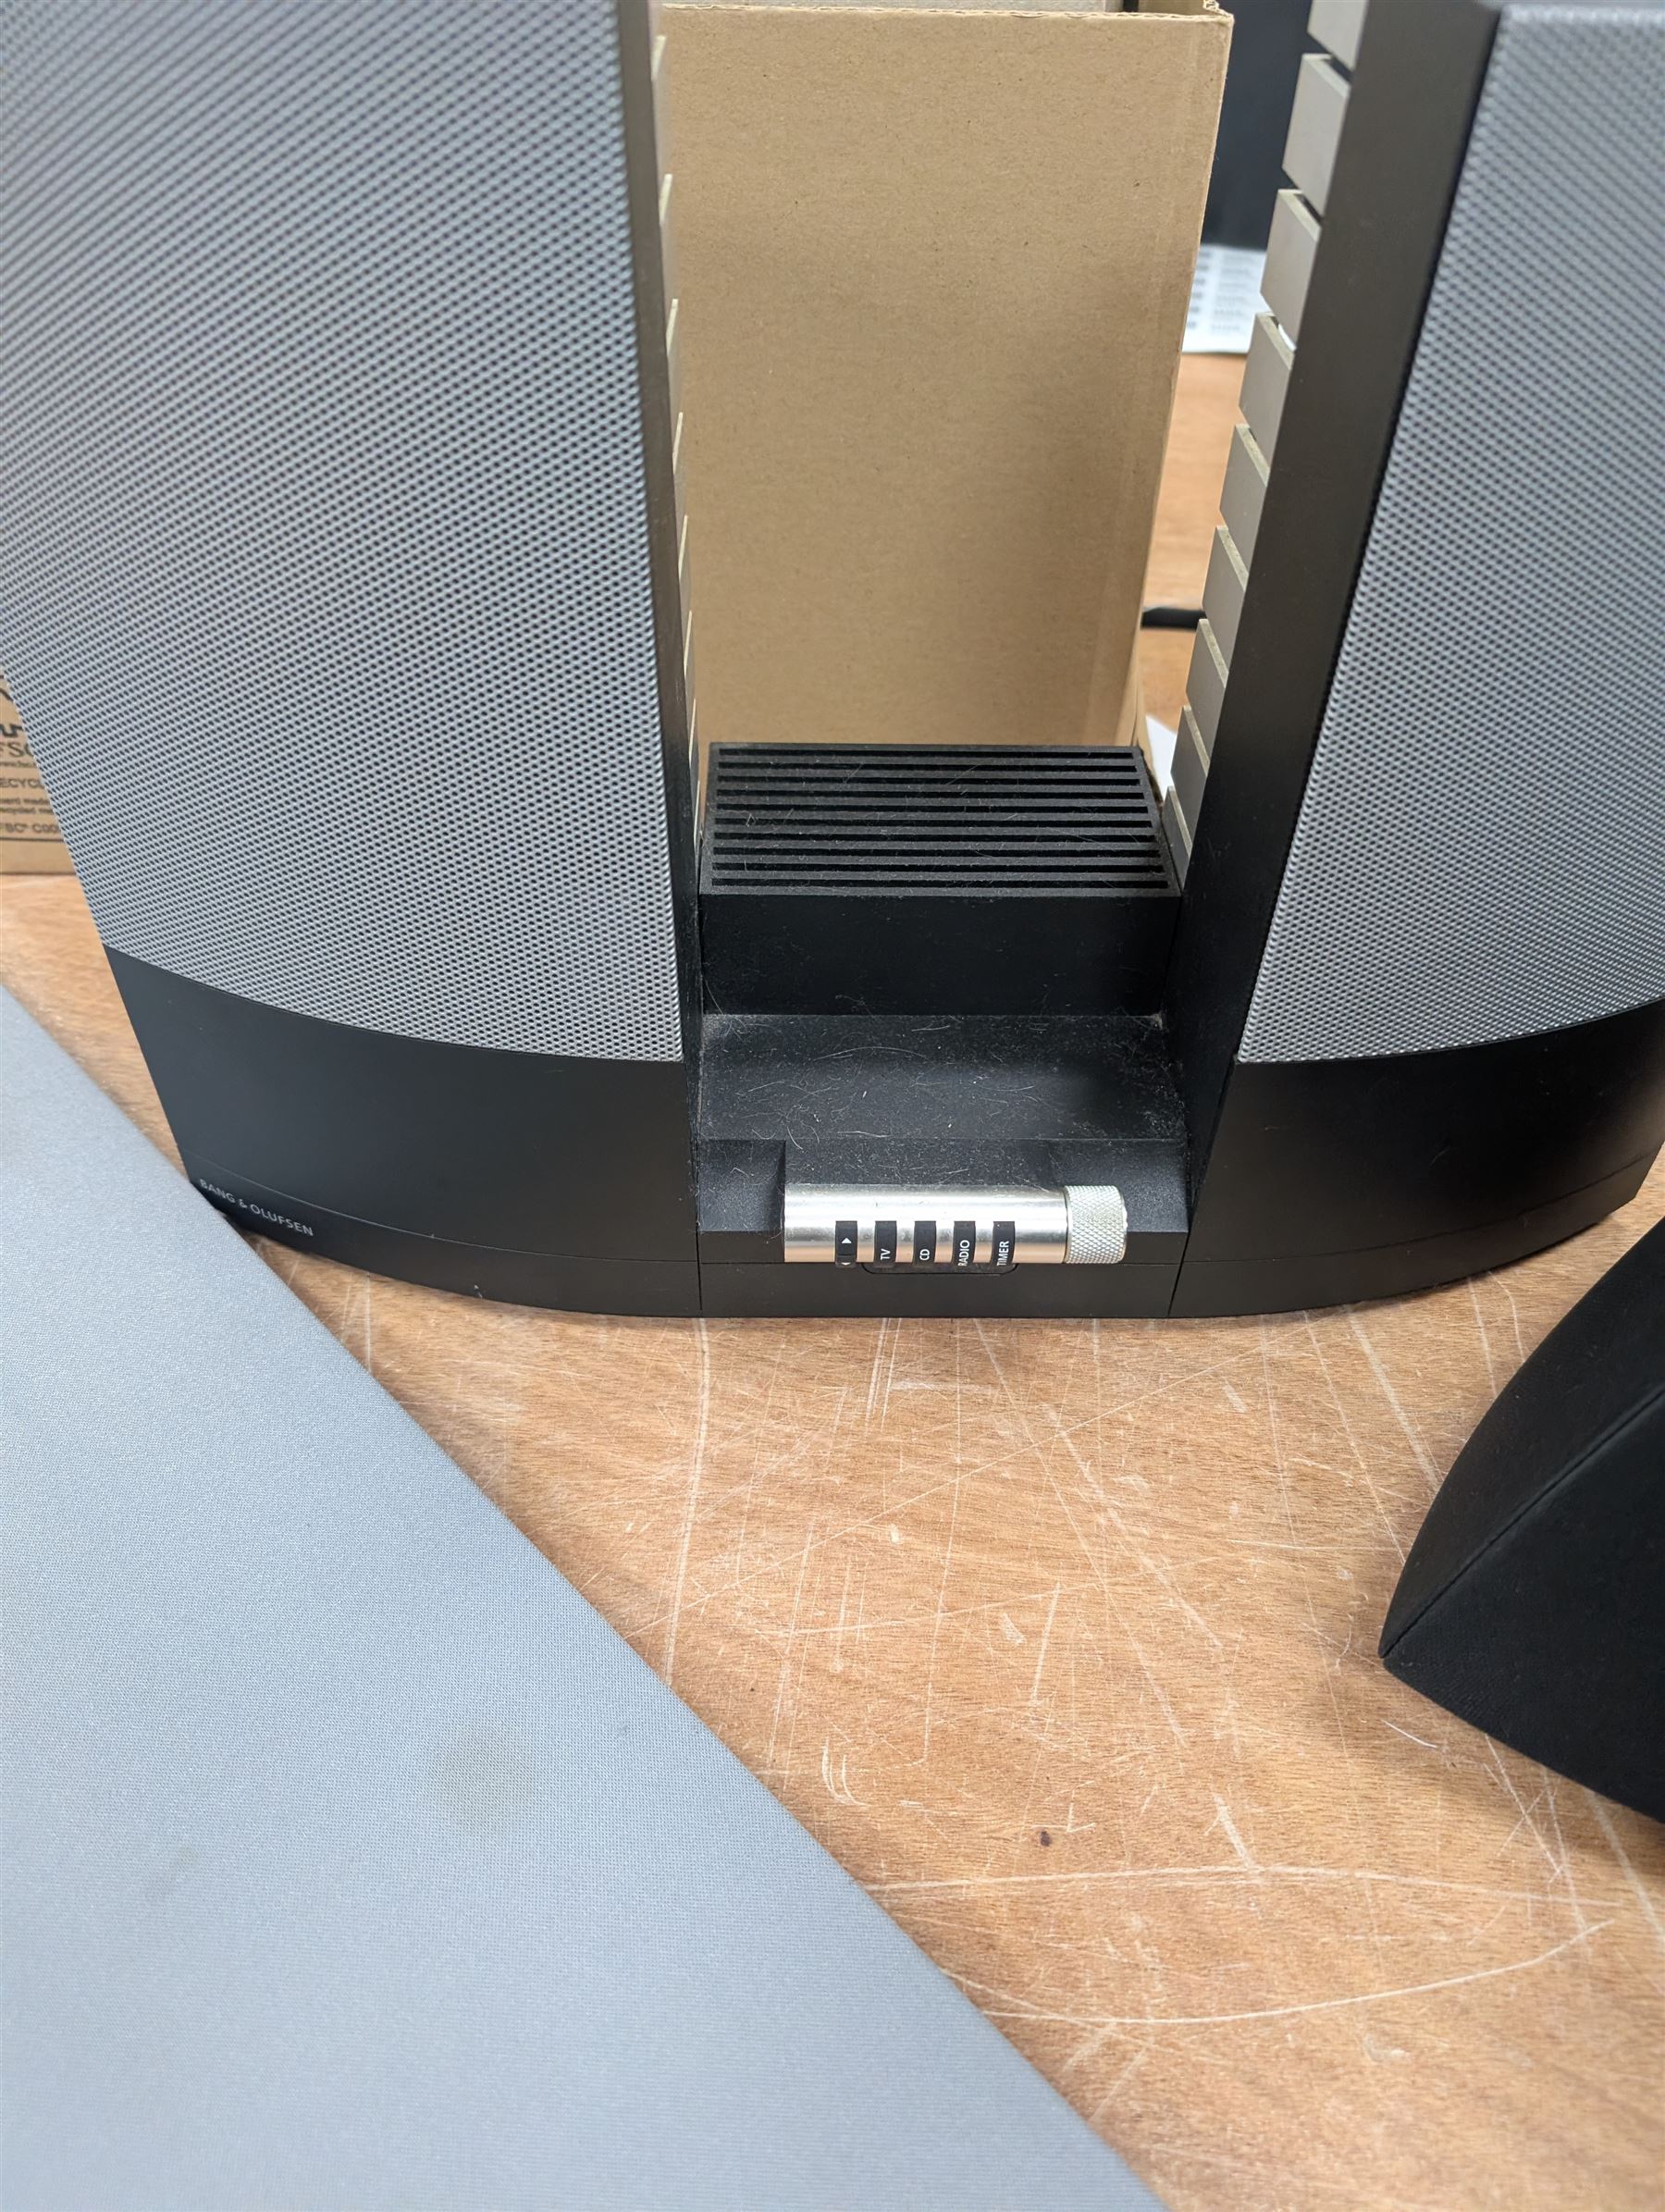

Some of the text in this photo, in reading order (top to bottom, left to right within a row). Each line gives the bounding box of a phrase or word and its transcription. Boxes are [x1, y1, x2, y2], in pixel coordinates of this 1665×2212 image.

[199, 1179, 314, 1237] BANG & OLUFSEN
[880, 1248, 892, 1261] TV
[919, 1248, 931, 1261] CD
[957, 1240, 970, 1267] RADIO
[996, 1240, 1010, 1267] TIMER
